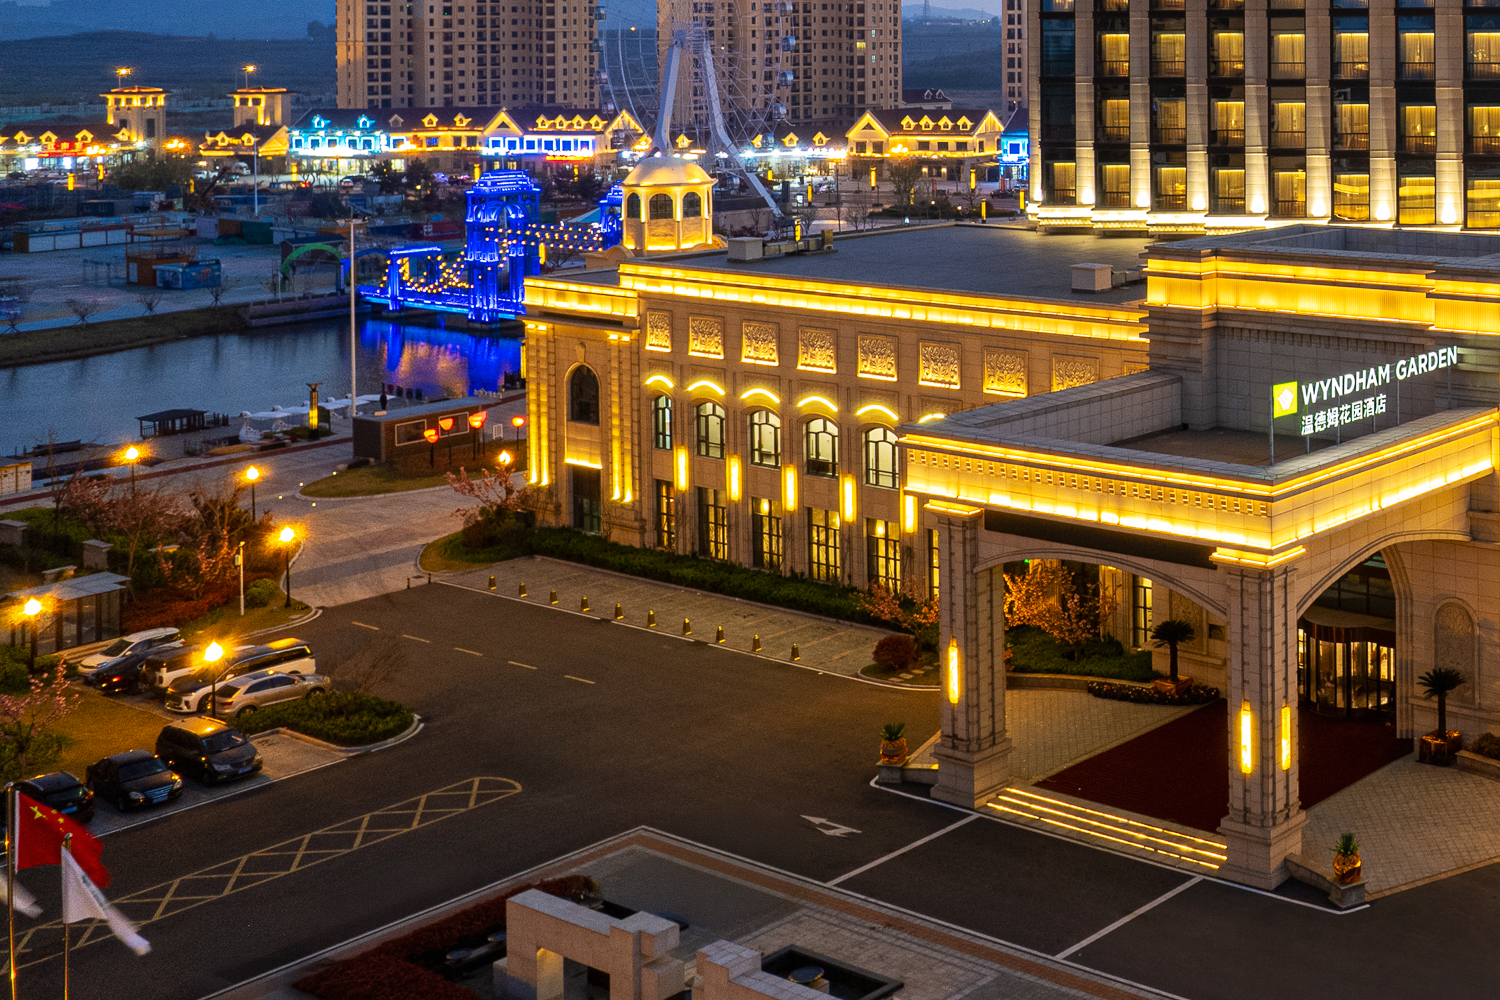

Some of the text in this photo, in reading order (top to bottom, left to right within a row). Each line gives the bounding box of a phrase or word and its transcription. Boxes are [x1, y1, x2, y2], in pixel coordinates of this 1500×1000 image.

[1301, 345, 1458, 406] WYNDHAM GARDEN
[1301, 393, 1387, 436] 温德姆花园酒店
